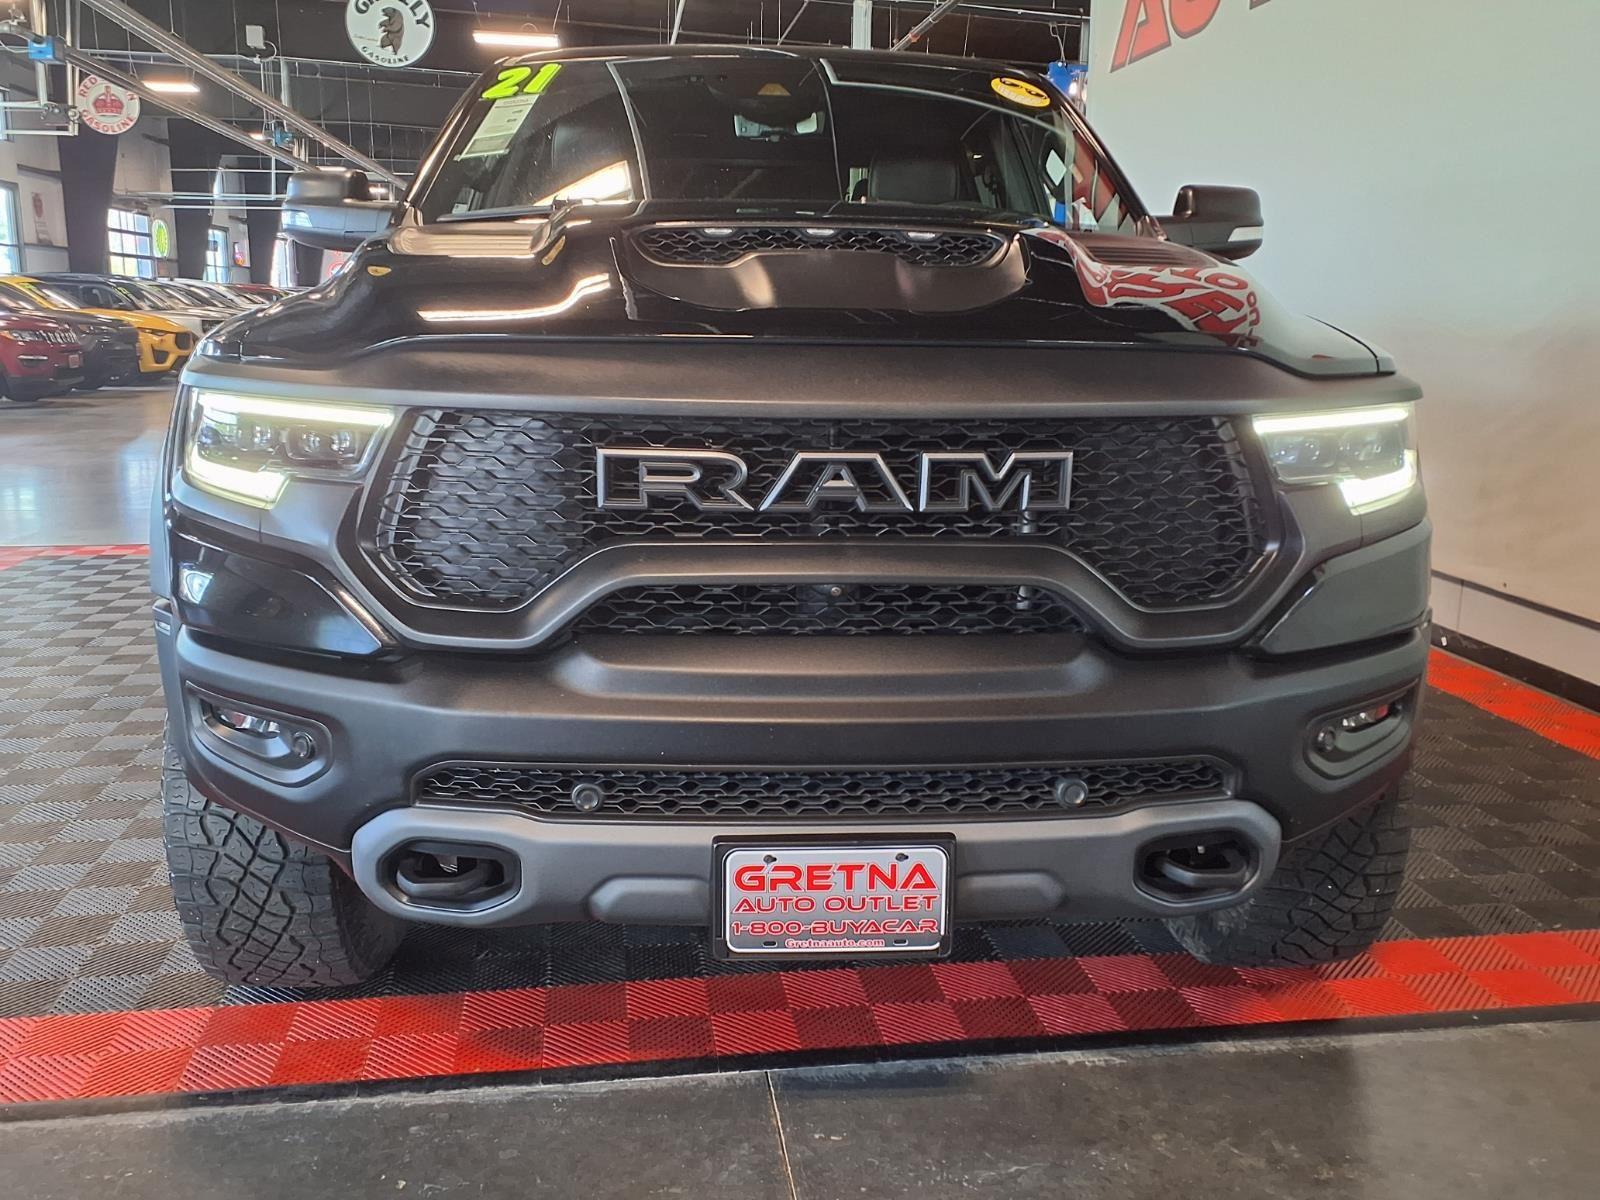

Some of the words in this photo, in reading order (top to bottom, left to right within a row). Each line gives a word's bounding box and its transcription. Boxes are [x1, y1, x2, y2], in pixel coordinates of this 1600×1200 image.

[361, 46, 409, 64] GASOLINE
[79, 76, 98, 98] RED
[481, 63, 562, 100] 21
[81, 109, 135, 133] GASOLINE
[596, 448, 1073, 512] RAM
[733, 862, 939, 892] GRETNA
[732, 896, 816, 914] AUTO
[823, 895, 938, 913] OUTLET
[732, 919, 938, 936] 1-800-BUYACAR
[784, 938, 885, 949] Gretnaauto.com
